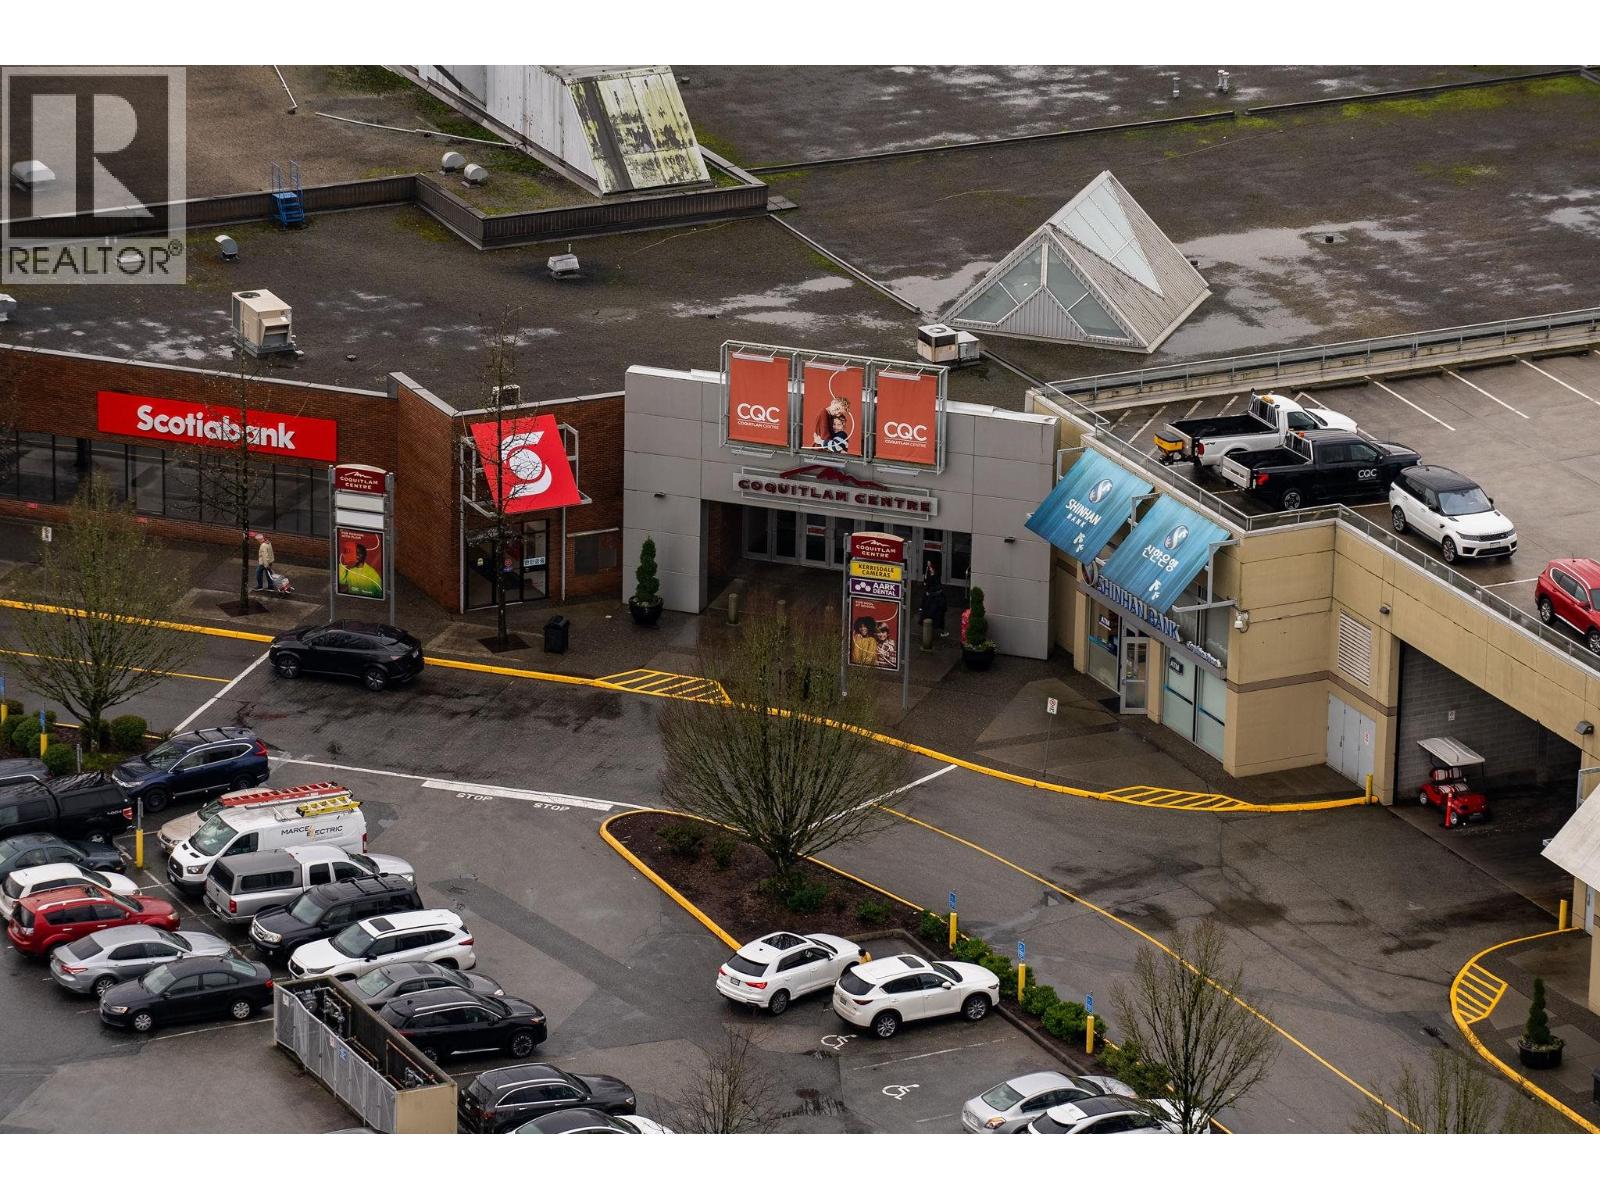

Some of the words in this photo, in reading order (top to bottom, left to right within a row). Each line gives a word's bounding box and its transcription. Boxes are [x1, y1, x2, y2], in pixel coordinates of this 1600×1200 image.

[737, 403, 780, 423] CQC
[136, 404, 296, 450] Scotiabank
[883, 421, 928, 441] CQC
[1358, 468, 1377, 478] CQC
[339, 476, 379, 485] COQUITLAM
[344, 482, 372, 490] CENTRE
[737, 478, 850, 503] COQUITLAM
[854, 492, 932, 513] CENTRE
[1065, 498, 1102, 526] SHINHAN
[856, 545, 896, 553] COQUITLAM
[1142, 544, 1180, 572] 신한은행
[859, 564, 895, 573] KERRISDALE
[862, 569, 891, 578] CAMERAS
[872, 582, 896, 592] AARK
[872, 588, 896, 597] DENTAL
[456, 792, 493, 801] STOP
[533, 802, 570, 812] STOP
